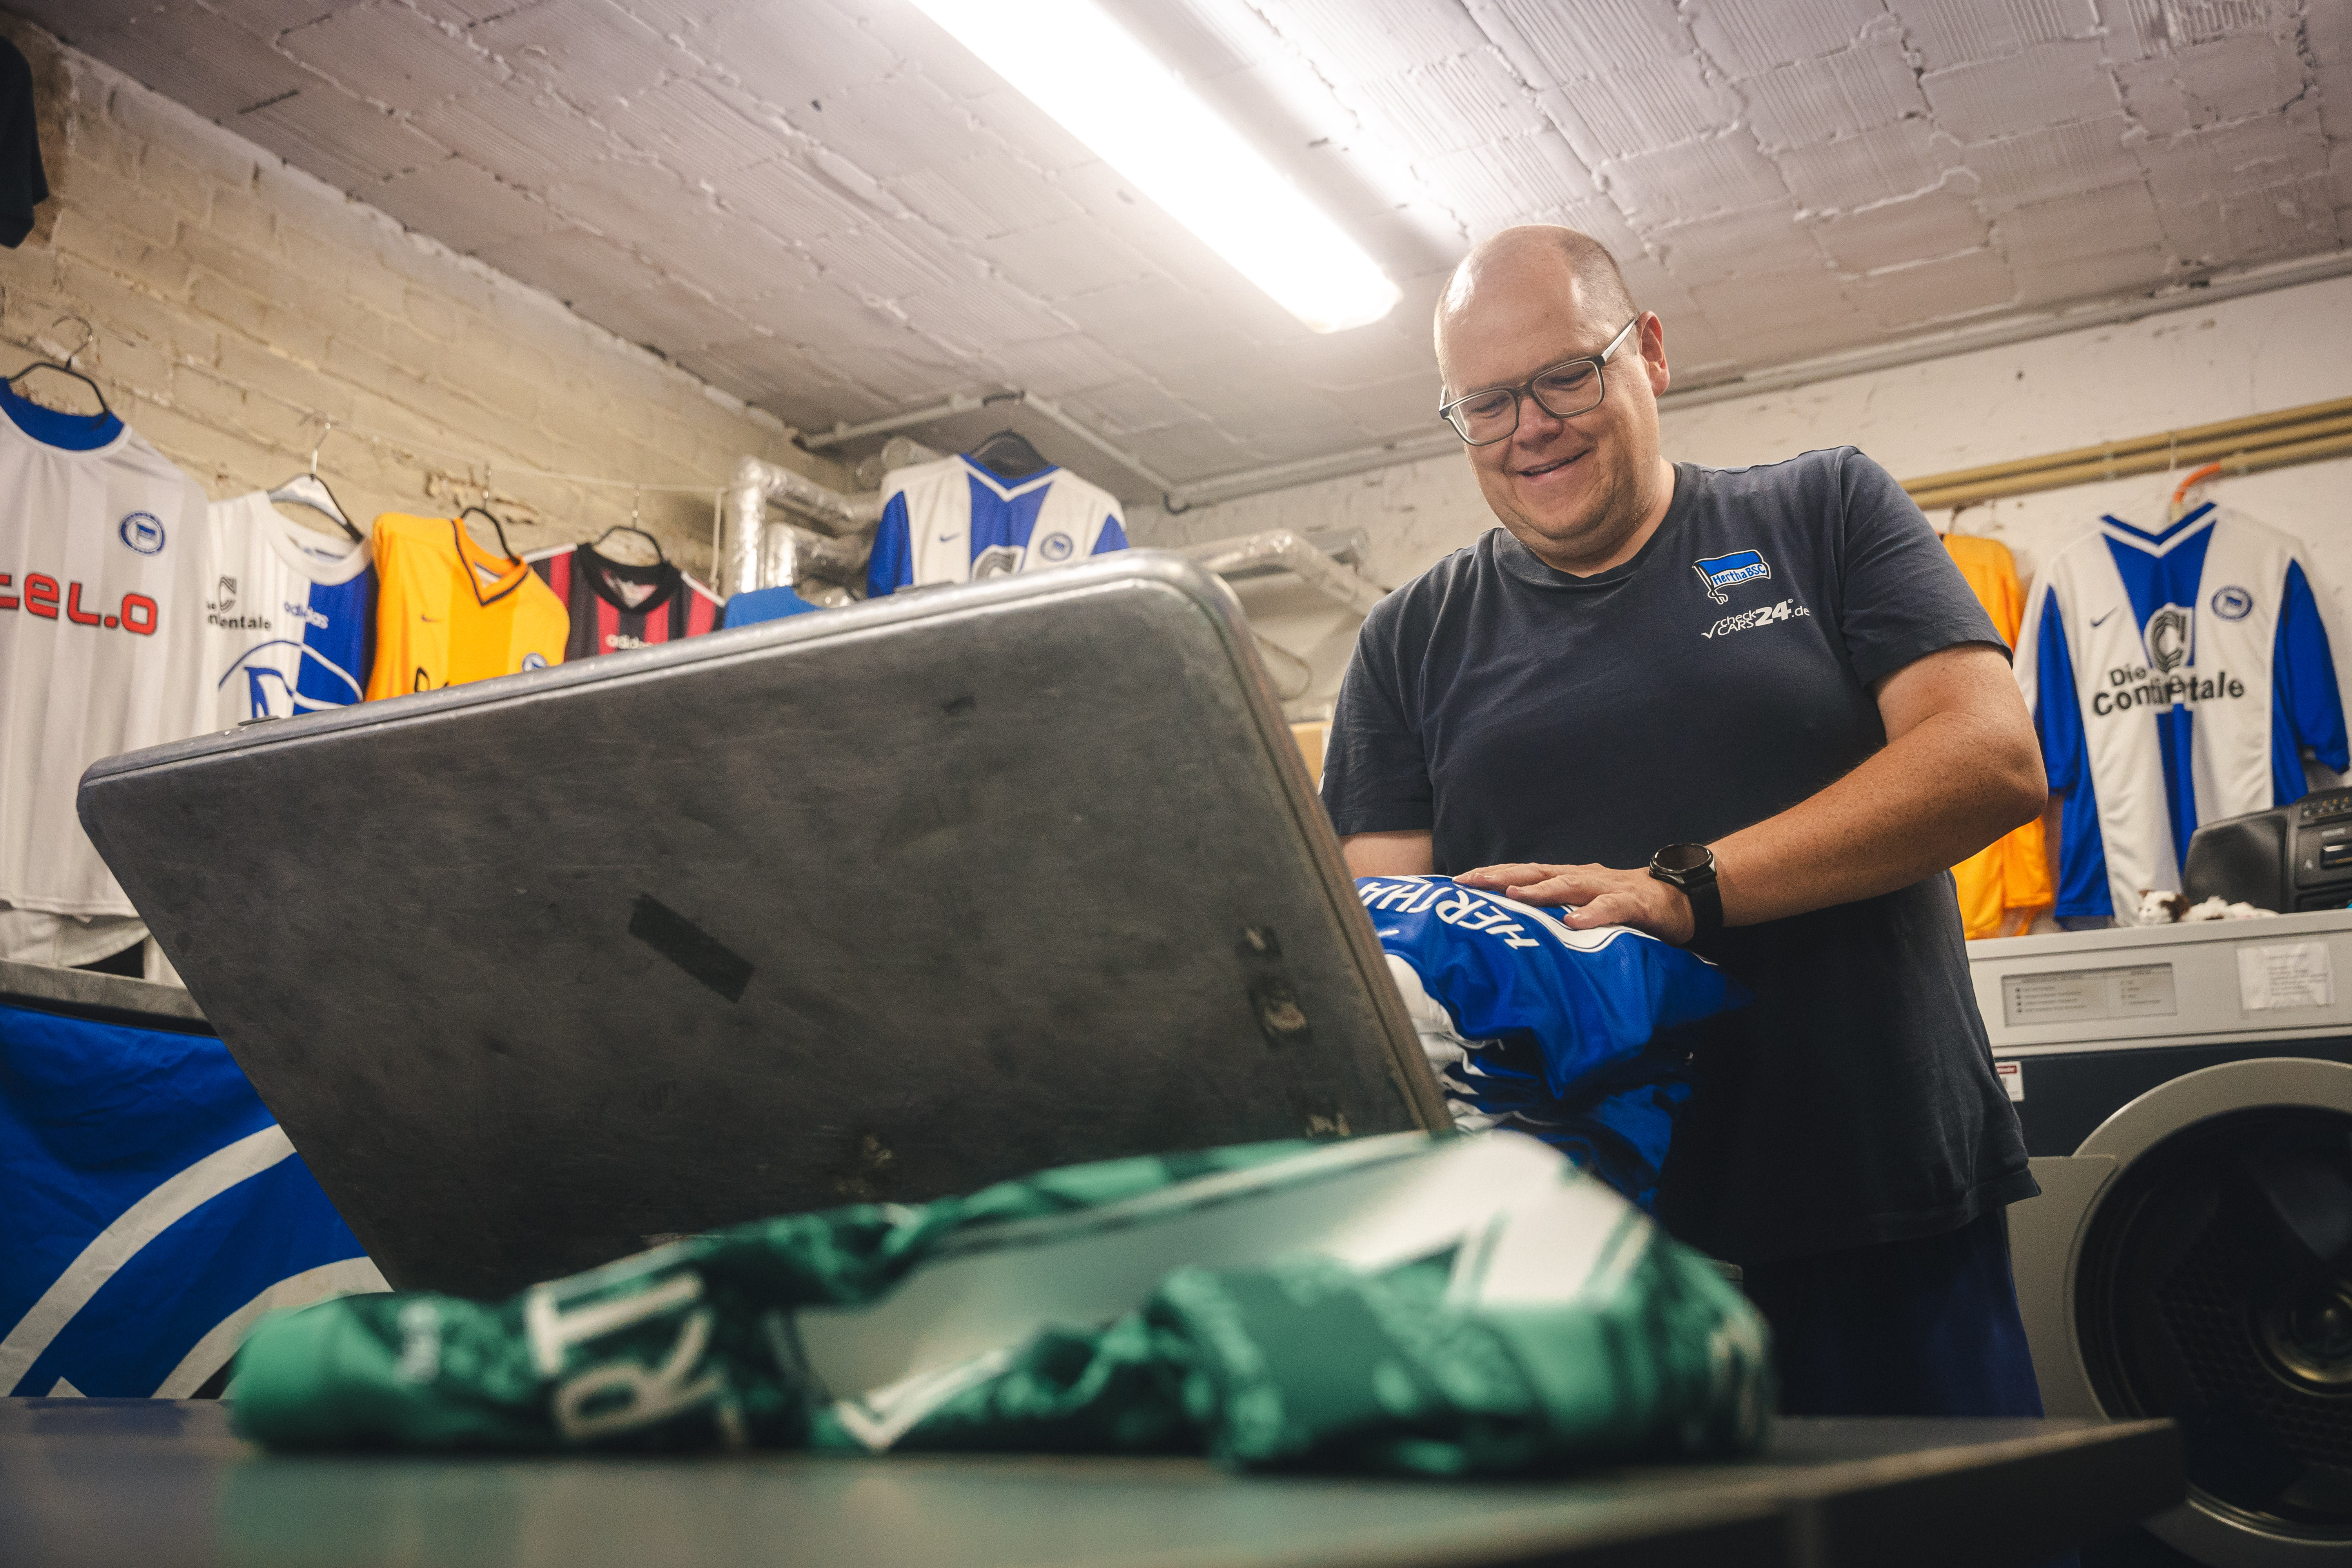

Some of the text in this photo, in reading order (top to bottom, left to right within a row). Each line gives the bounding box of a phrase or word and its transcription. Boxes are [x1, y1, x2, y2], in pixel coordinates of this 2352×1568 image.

[1712, 564, 1766, 585] Hertha BSC
[1720, 610, 1757, 627] check
[2109, 664, 2147, 686] Die
[2093, 671, 2245, 716] Contietale
